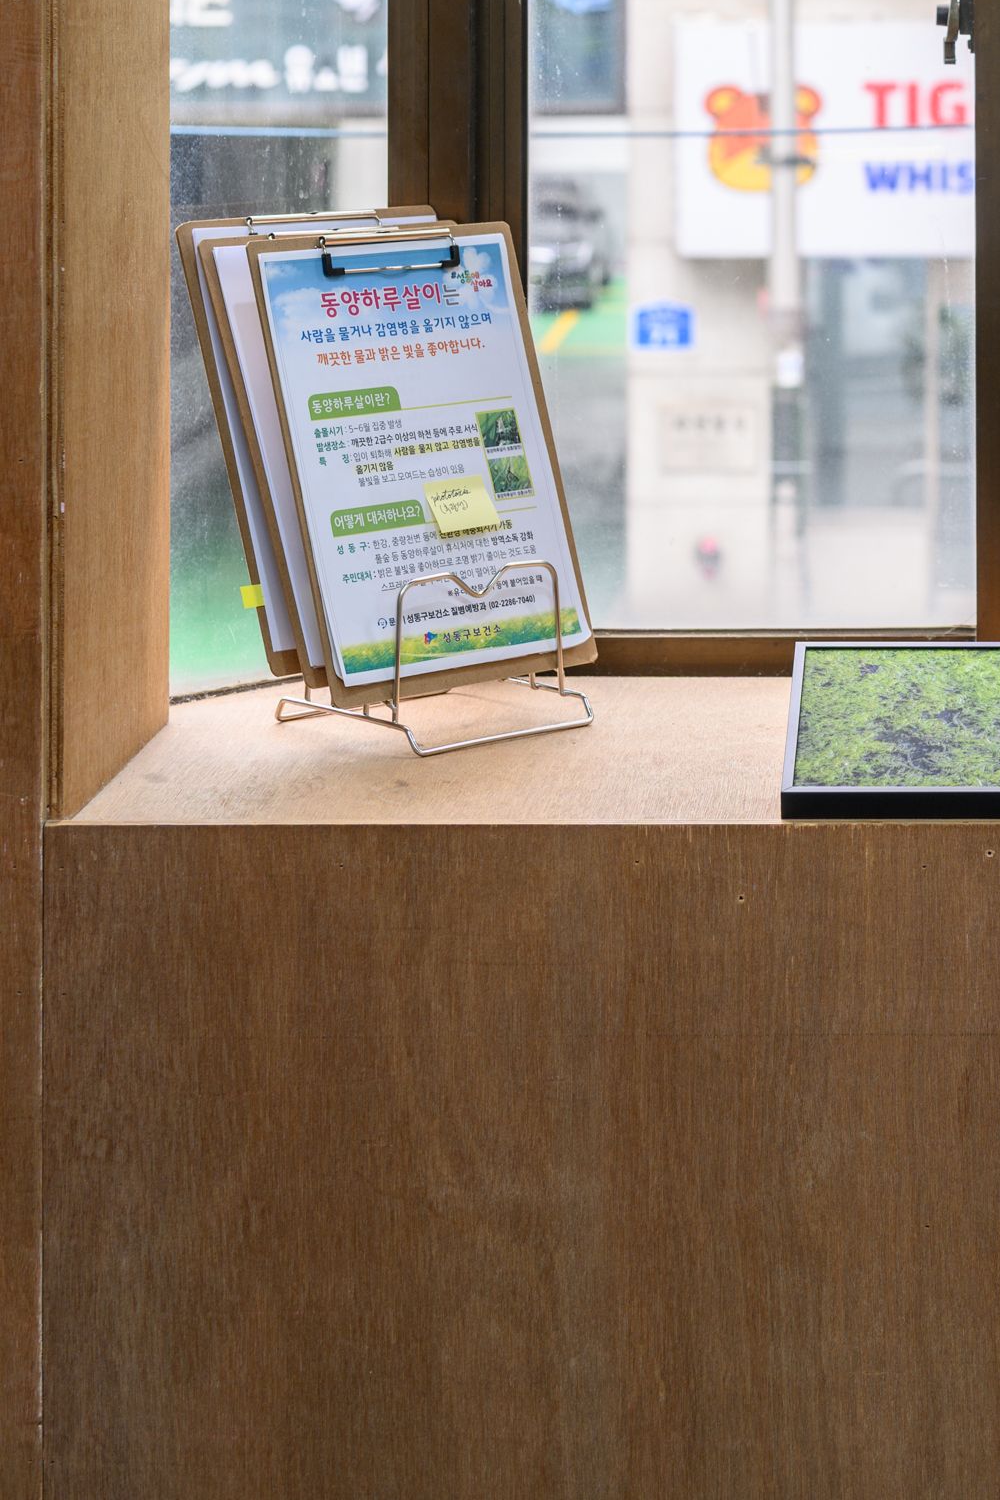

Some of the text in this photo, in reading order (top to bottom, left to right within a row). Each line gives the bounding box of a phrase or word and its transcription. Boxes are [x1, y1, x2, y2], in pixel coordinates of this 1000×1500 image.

[321, 283, 460, 318] 동양하루살이는
[300, 312, 492, 344] 사람을 물거나 감염병을 옮기지 않으며
[316, 338, 486, 367] 깨끗한 물과 밝은 빛을 좋아합니다.
[312, 393, 391, 414] 동양하루살이란?
[372, 420, 387, 432] 집중
[387, 419, 402, 429] 발생
[316, 440, 346, 452] 발생장소
[351, 436, 374, 448] 깨끗한
[375, 434, 394, 446] 2급수
[395, 431, 417, 443] 이상의
[417, 428, 432, 439] 하천
[433, 427, 448, 438] 등에
[448, 425, 463, 436] 주로
[464, 423, 478, 433] 서식
[394, 445, 416, 457] 사람을
[418, 443, 433, 454] 물지
[435, 441, 449, 452] 않고
[452, 436, 480, 449] 감염병을
[355, 461, 394, 475] 옮기지 않음
[381, 473, 397, 483] 보고
[398, 469, 427, 481] 모여드는
[427, 465, 449, 477] 습성이
[450, 463, 465, 474] 있음
[334, 505, 421, 529] 어떻게 대처하나요?
[401, 544, 445, 560] 동양하루살이
[475, 537, 490, 548] 대한
[491, 533, 519, 546] 방역소독
[520, 531, 534, 542] 강화
[342, 570, 373, 584] 주민대처
[455, 555, 469, 566] 조명
[509, 547, 523, 557] 것도
[523, 544, 537, 555] 도움
[406, 609, 450, 624] 성동구보건소
[450, 602, 487, 616] 질병예방과
[442, 624, 501, 643] 성동구보건소
